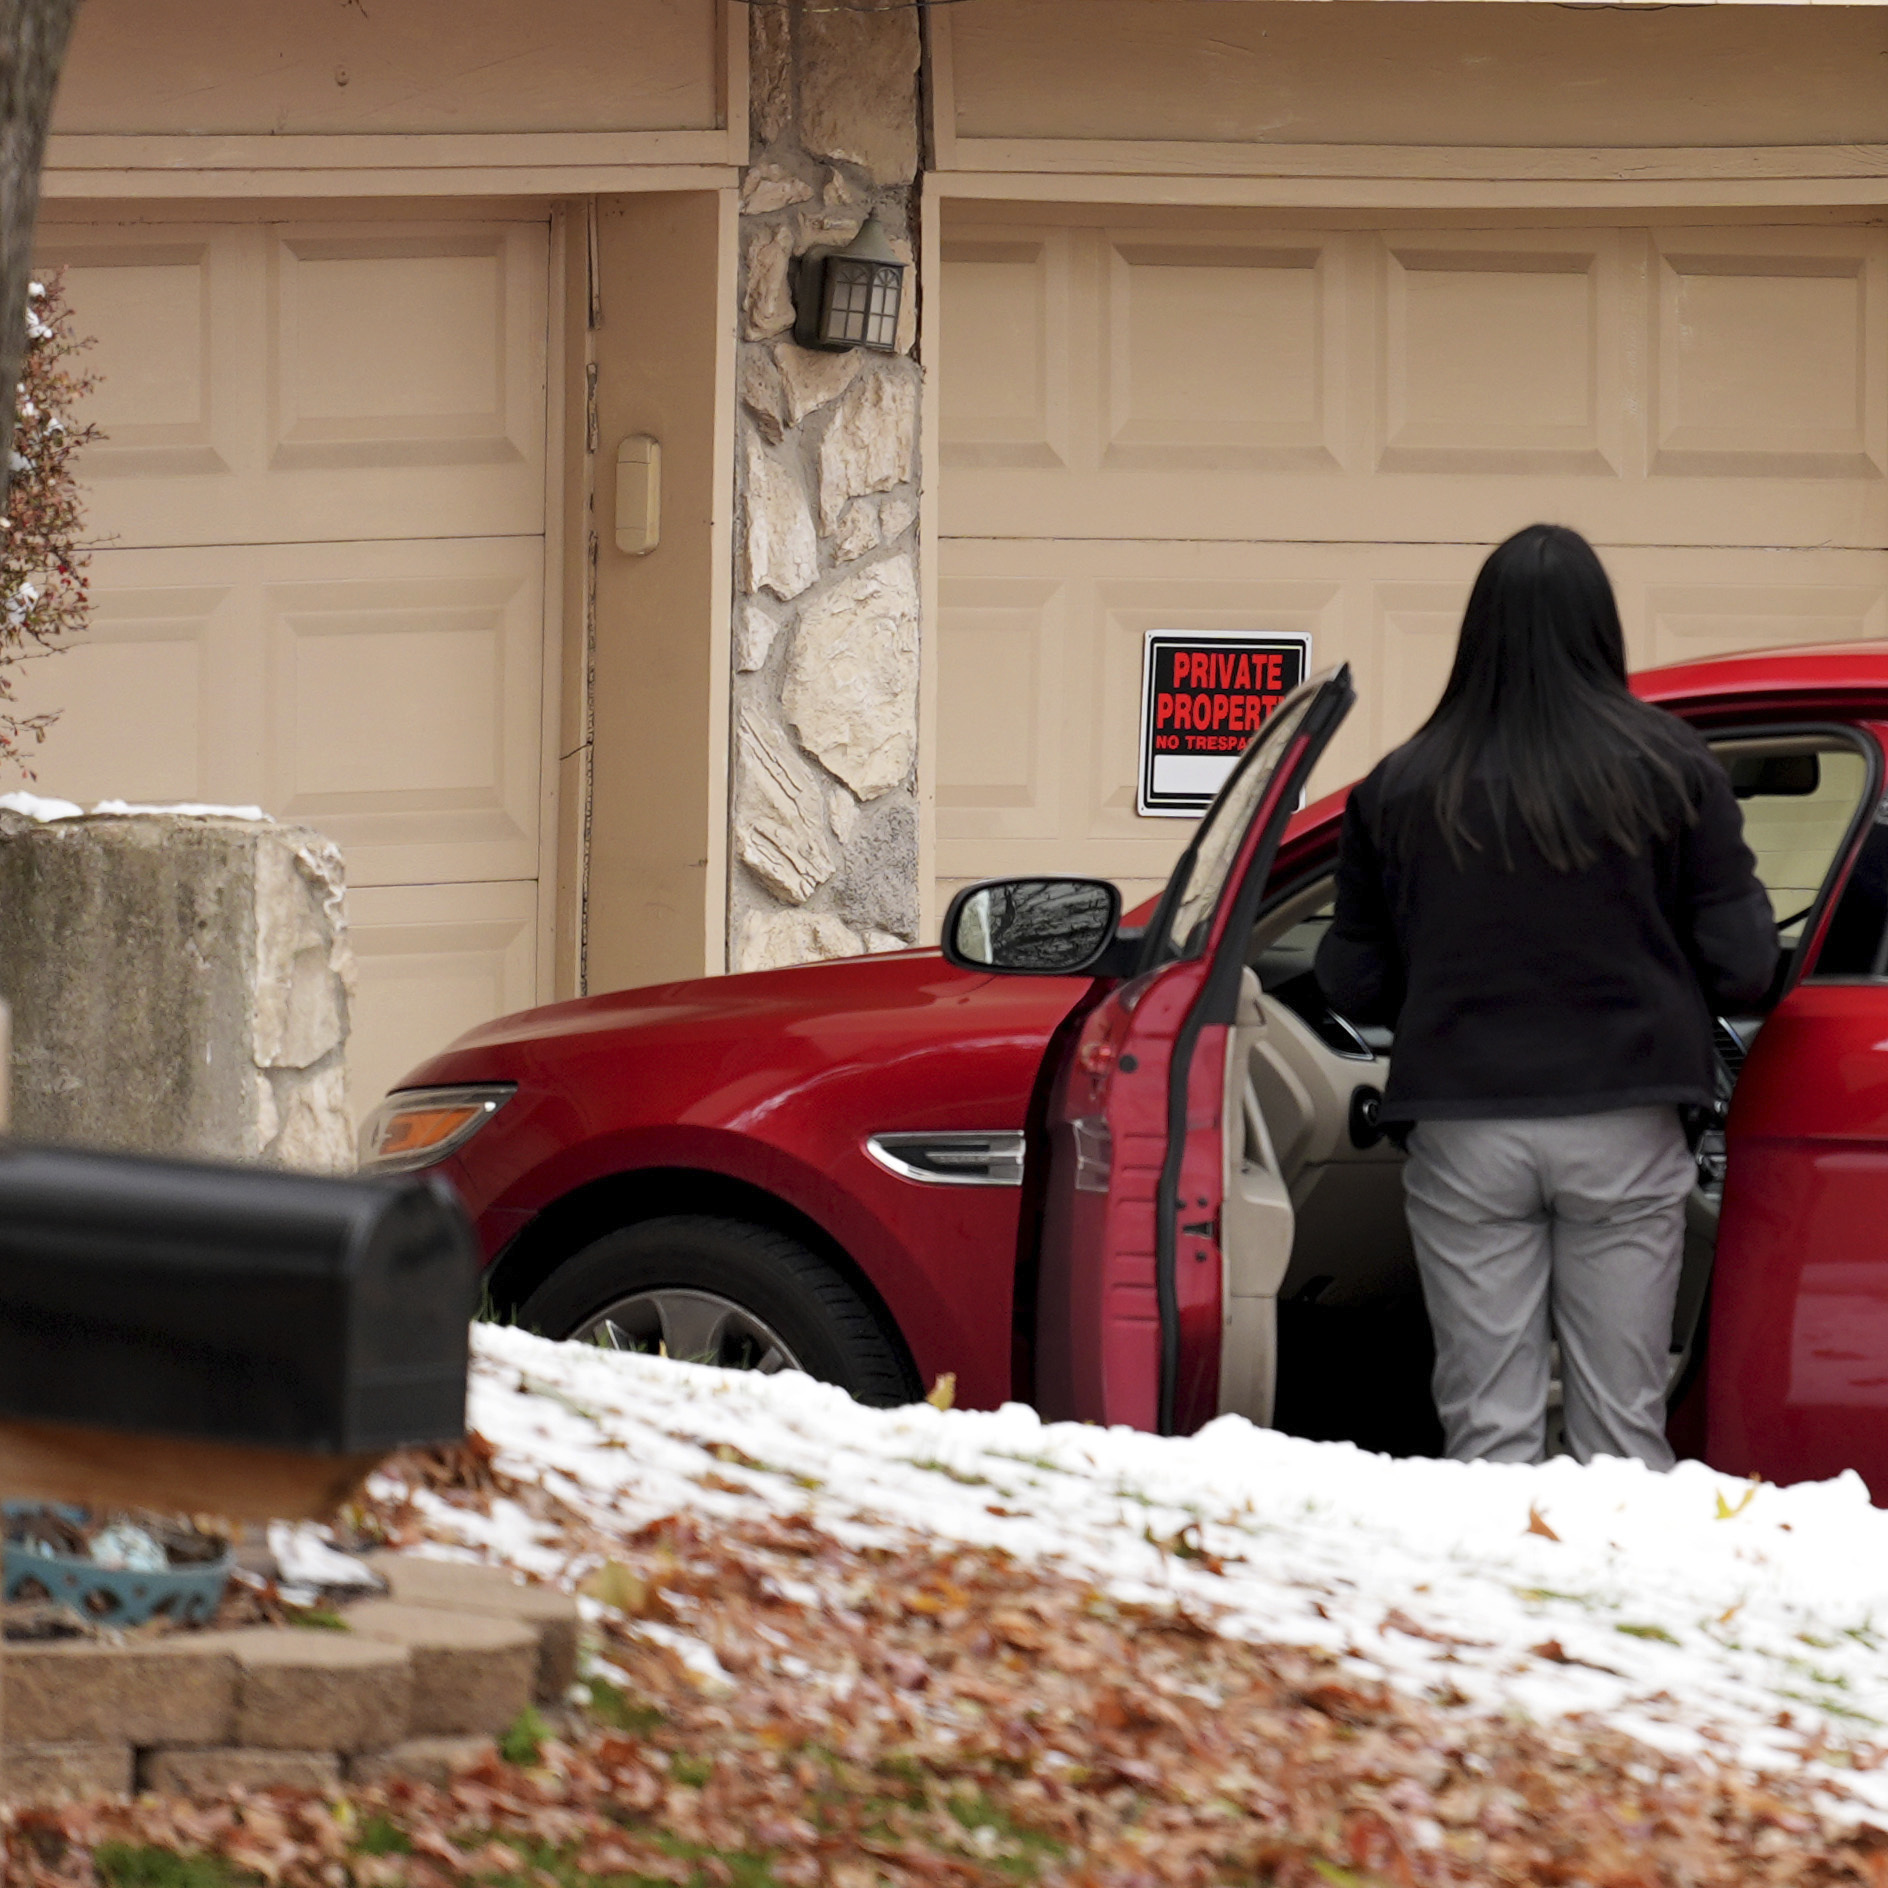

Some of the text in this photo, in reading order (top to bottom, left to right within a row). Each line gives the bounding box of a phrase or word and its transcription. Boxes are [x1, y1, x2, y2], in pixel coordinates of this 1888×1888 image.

[1173, 652, 1283, 690] PRIVATE
[1156, 692, 1285, 731] PROPERT
[1155, 735, 1255, 751] NO TRESPA
